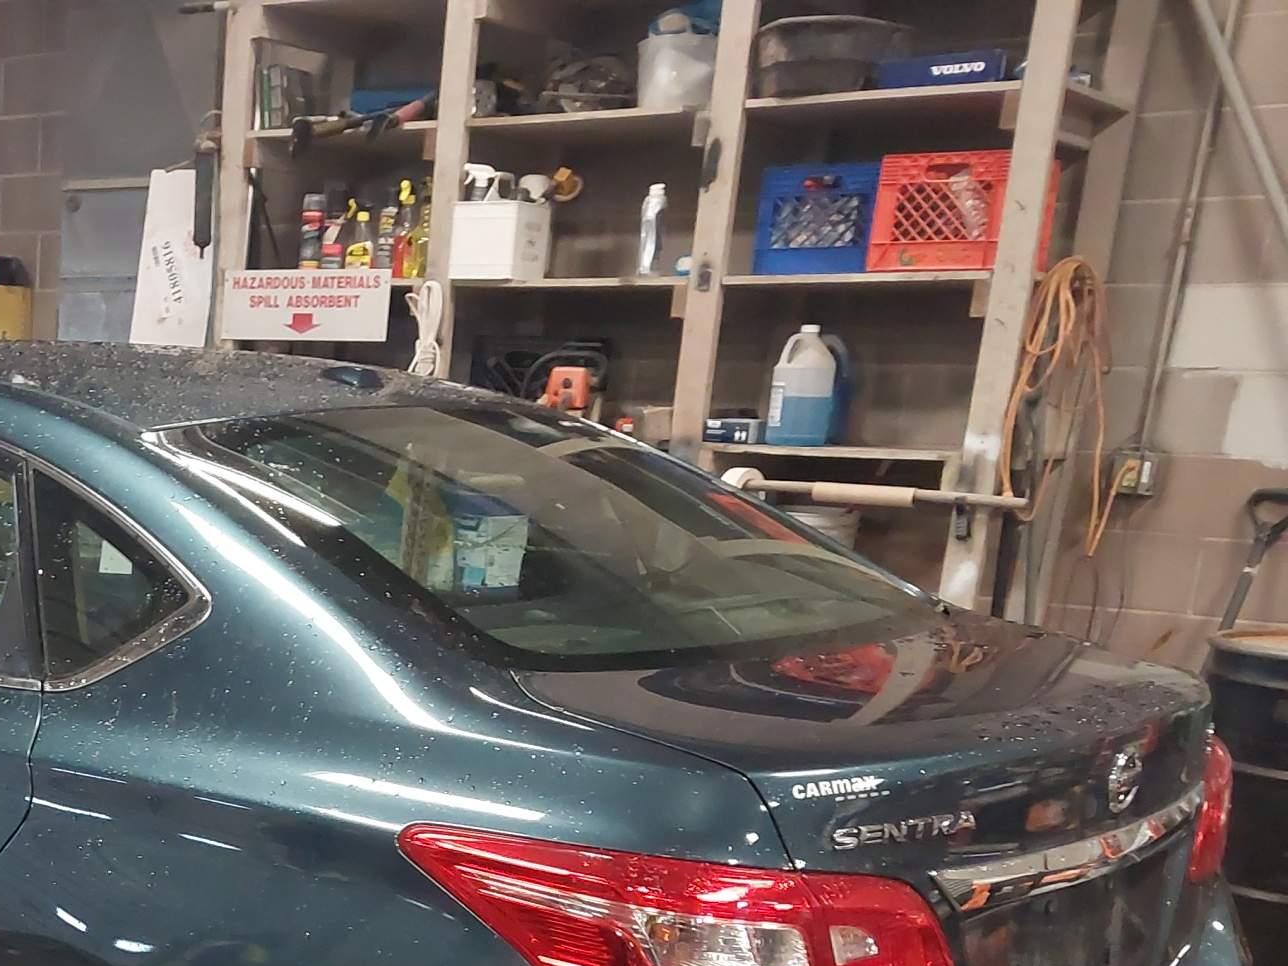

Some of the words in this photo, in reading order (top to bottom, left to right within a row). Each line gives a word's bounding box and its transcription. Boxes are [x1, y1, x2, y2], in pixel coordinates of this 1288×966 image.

[930, 61, 986, 75] VOLVO
[232, 276, 306, 289] HAZARDOUS
[312, 275, 381, 289] MATERIALS
[249, 295, 280, 308] SPILL
[286, 295, 360, 308] ABSORBENT
[831, 809, 976, 851] SENTRA
